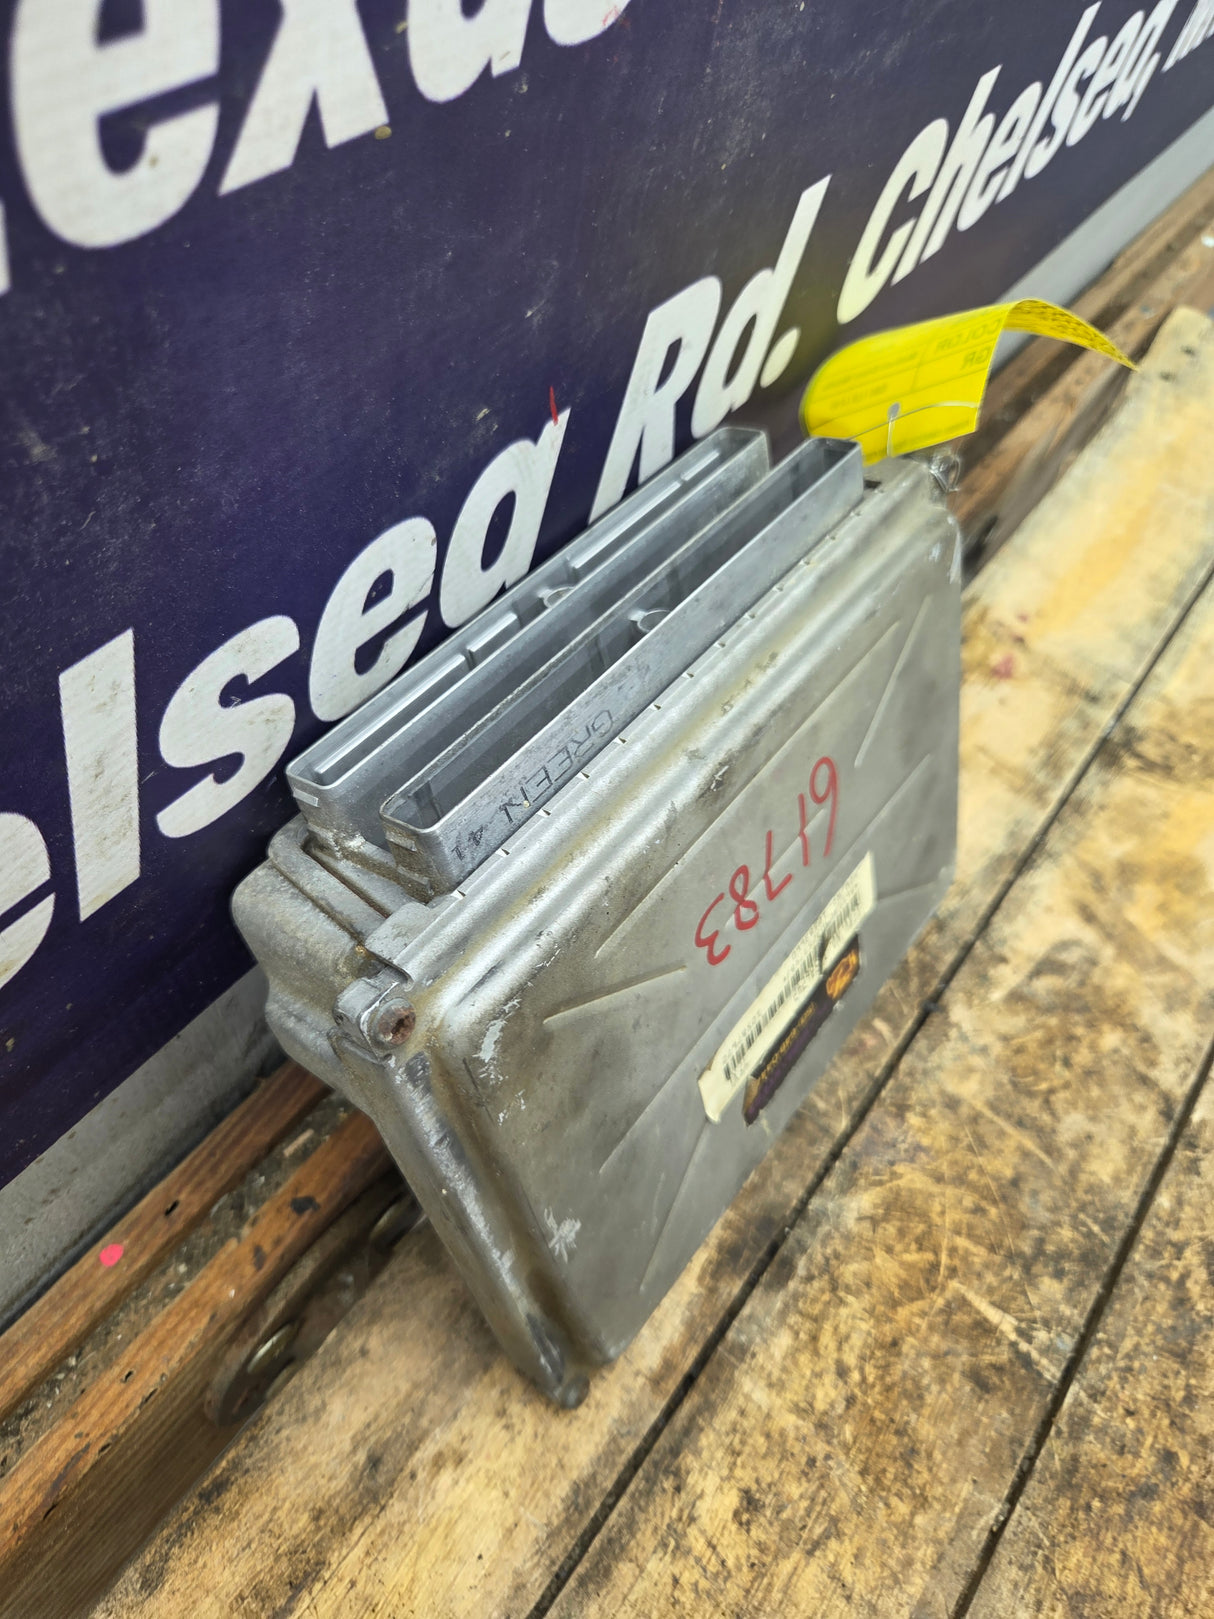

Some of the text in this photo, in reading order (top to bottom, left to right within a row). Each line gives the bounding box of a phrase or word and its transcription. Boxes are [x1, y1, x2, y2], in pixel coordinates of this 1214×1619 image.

[588, 174, 832, 525] Rd.
[837, 0, 1178, 324] Chelsea,
[500, 709, 613, 823] GREEN
[695, 757, 838, 965] 61783
